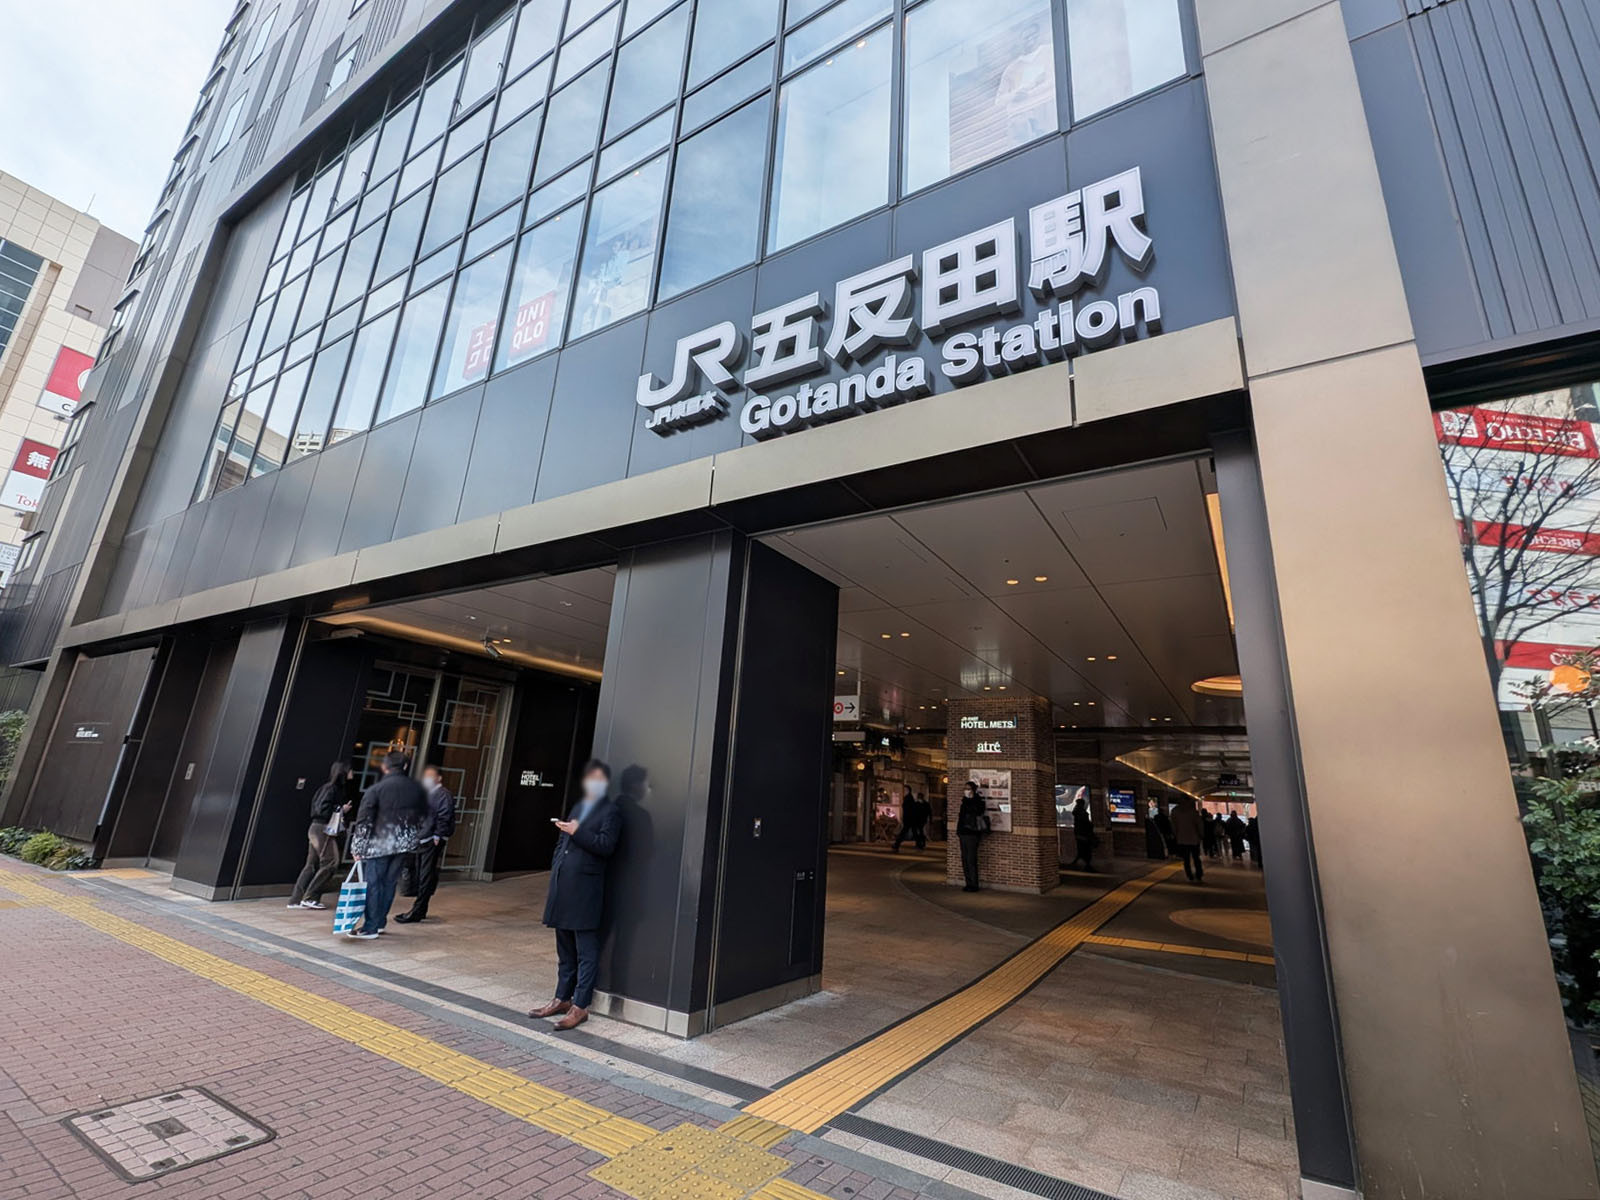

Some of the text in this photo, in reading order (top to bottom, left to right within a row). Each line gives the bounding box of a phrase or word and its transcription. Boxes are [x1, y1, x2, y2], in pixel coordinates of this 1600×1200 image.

[516, 300, 547, 328] UNI
[511, 320, 545, 351] QLO
[740, 286, 1160, 434] Gotanda Station
[960, 720, 1014, 729] HOTEL METS
